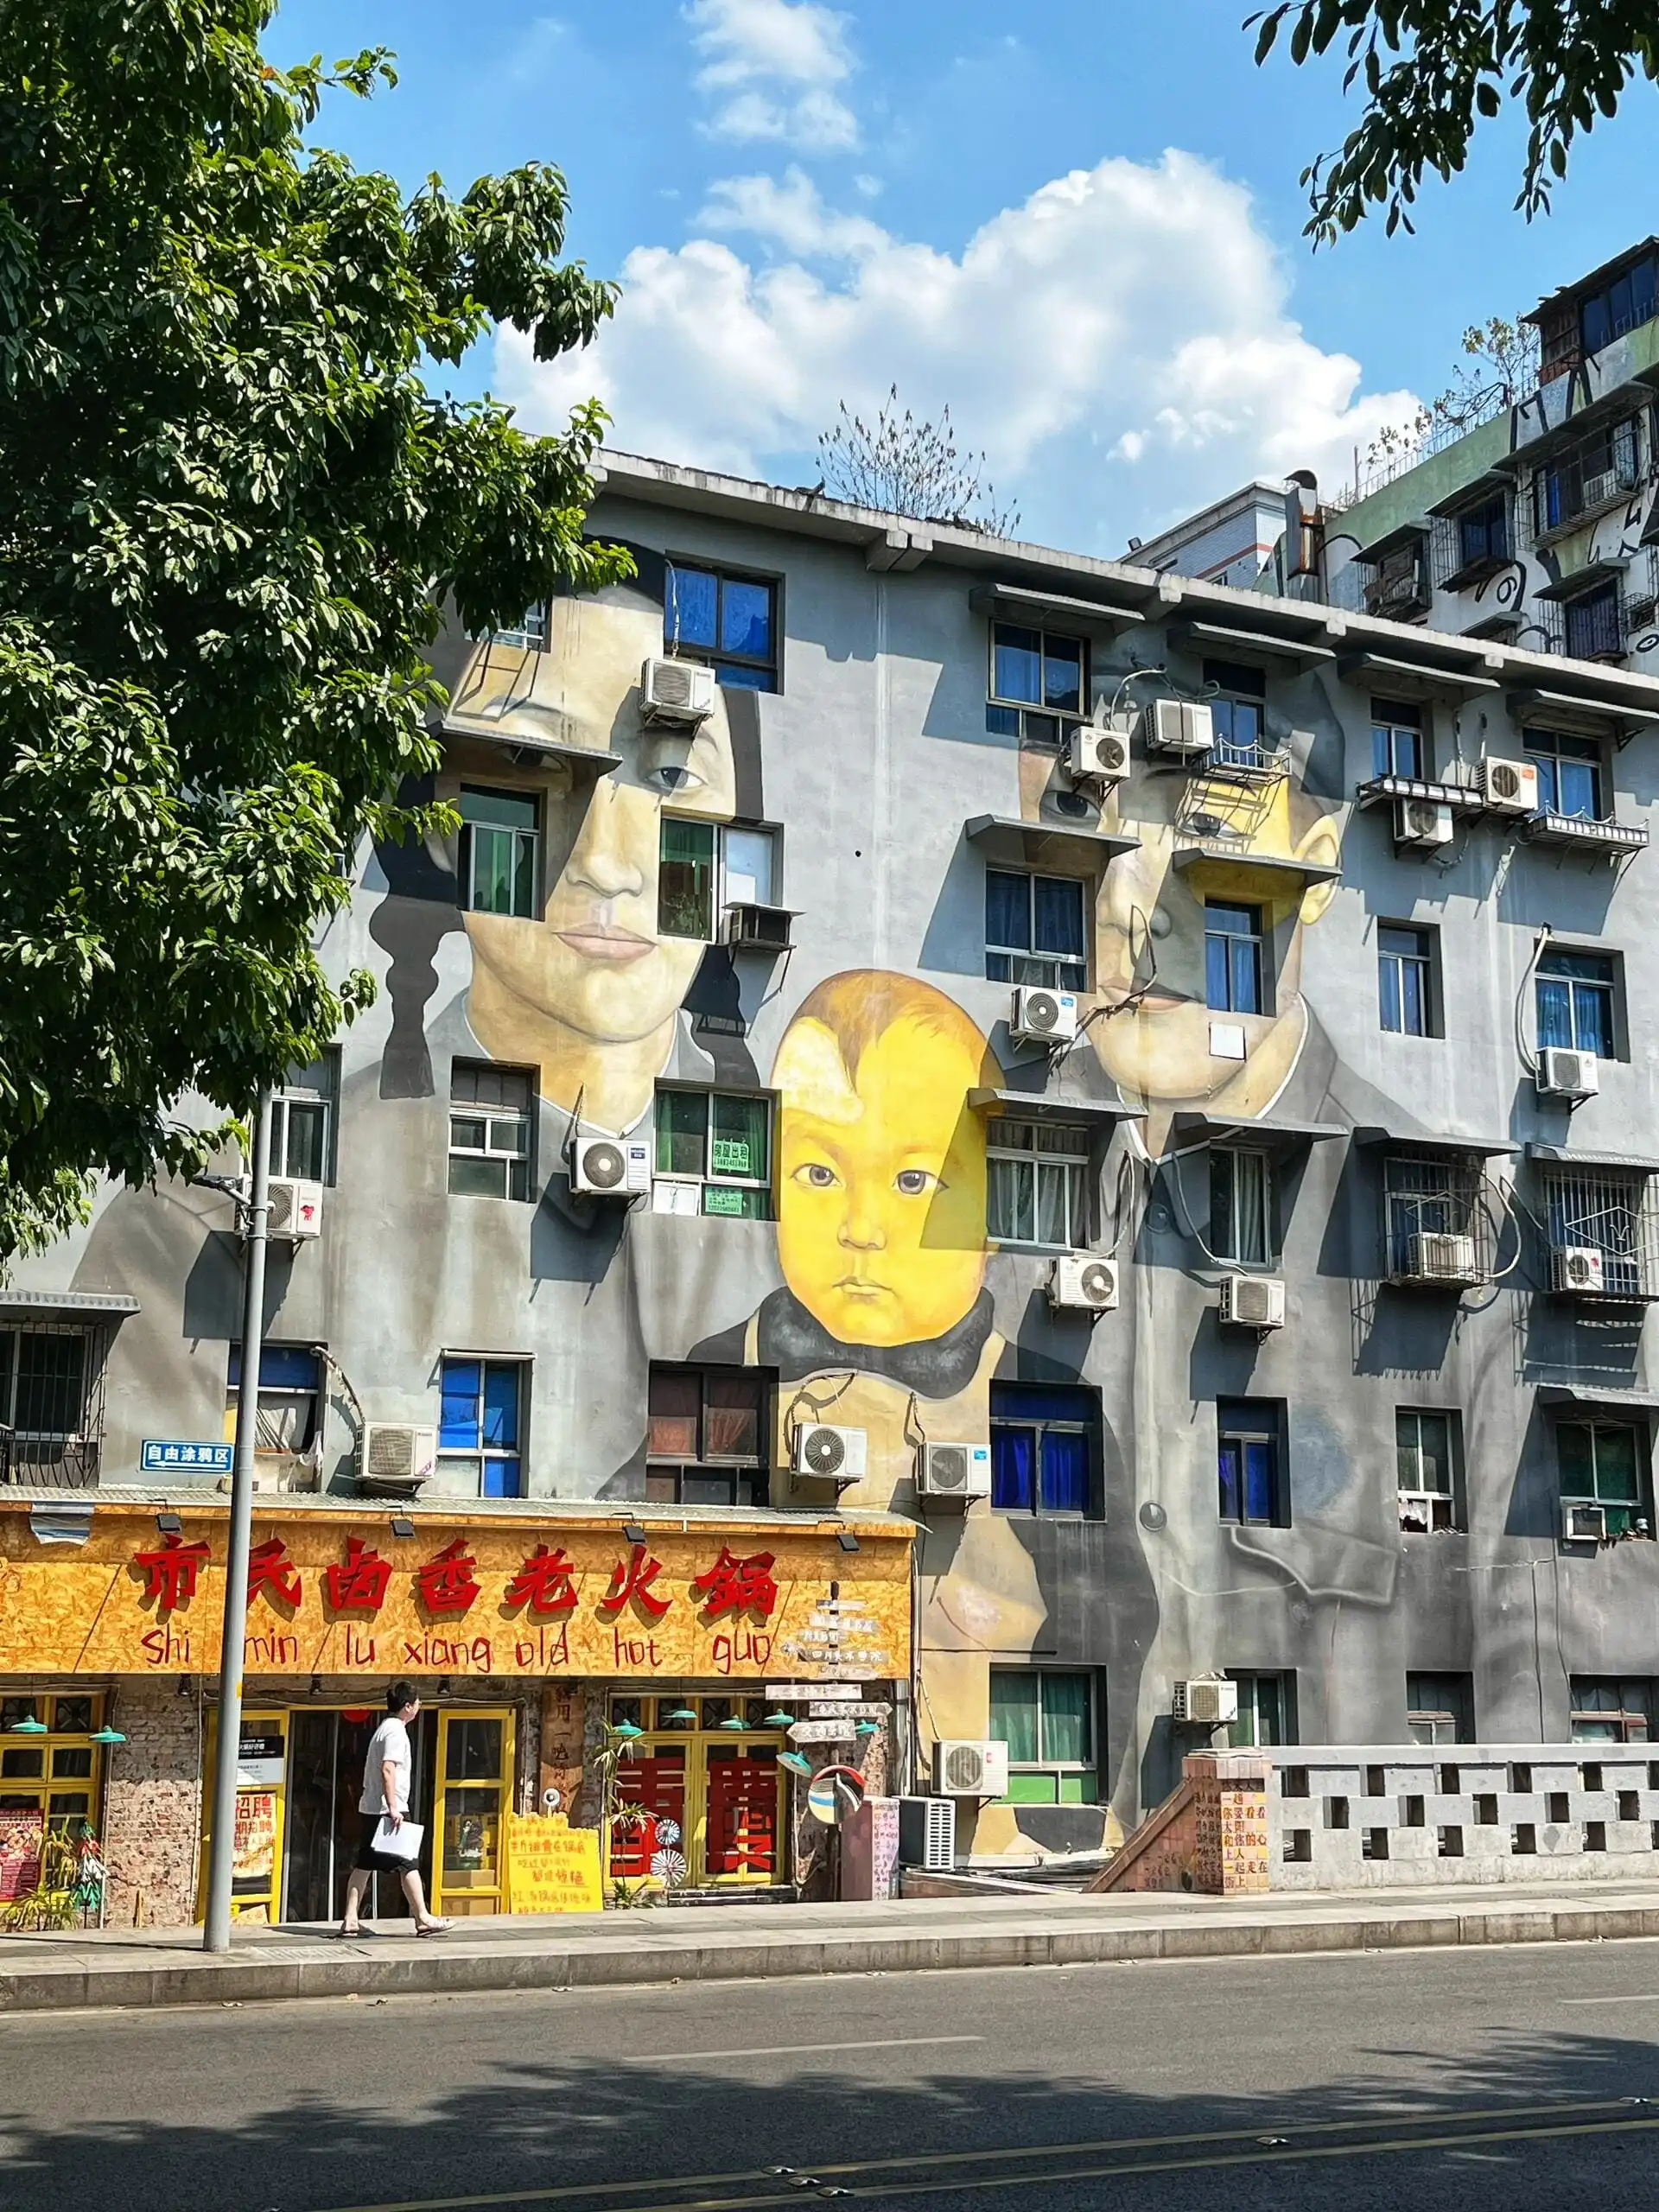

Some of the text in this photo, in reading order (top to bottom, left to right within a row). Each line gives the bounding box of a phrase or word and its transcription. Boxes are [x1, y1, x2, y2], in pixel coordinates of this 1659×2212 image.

[714, 1143, 748, 1160] 房屋出租
[147, 1444, 229, 1463] 自由涂鸦区
[244, 1627, 298, 1665] min
[346, 1624, 375, 1667] lu
[404, 1628, 492, 1674] xiang
[515, 1623, 569, 1667] old
[614, 1626, 663, 1668] hot
[712, 1625, 771, 1675] guo
[236, 1795, 273, 1819] 招聘
[1223, 1806, 1266, 1820] 你要看看
[1223, 1832, 1267, 1847] 和你的心
[1224, 1847, 1245, 1859] 上人
[1224, 1860, 1268, 1874] 一起走在
[1224, 1874, 1246, 1889] 街上
